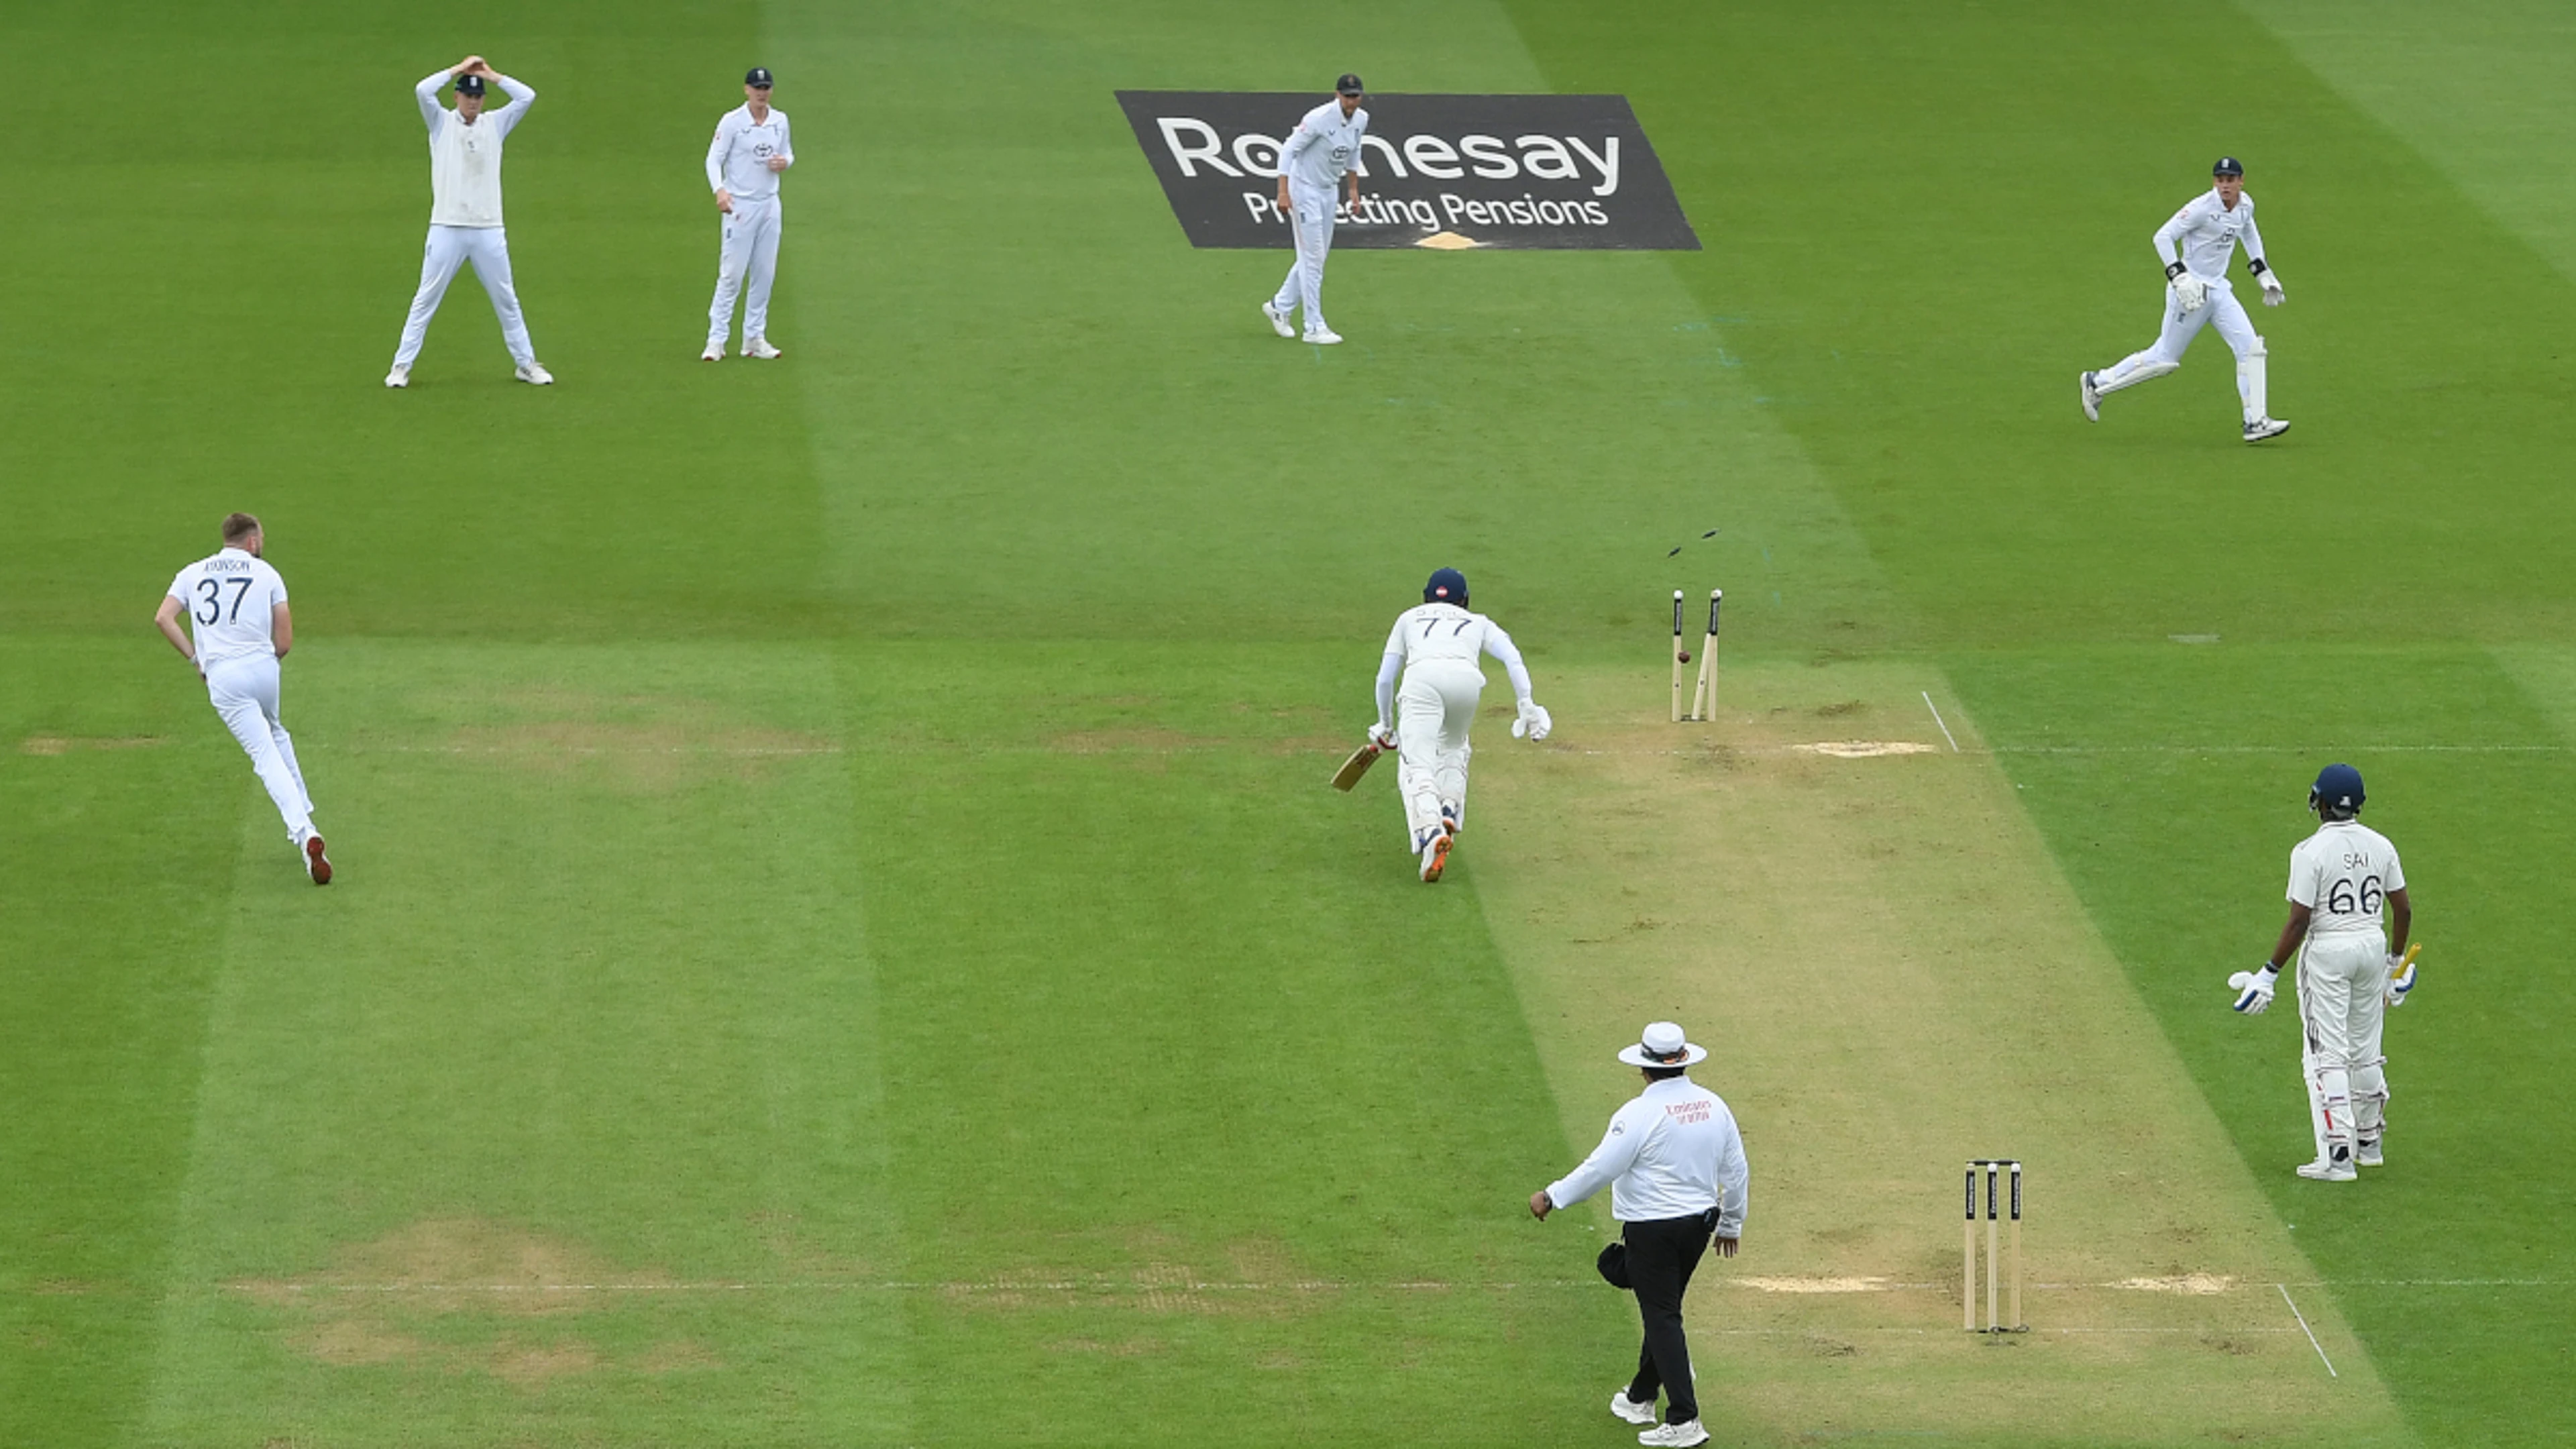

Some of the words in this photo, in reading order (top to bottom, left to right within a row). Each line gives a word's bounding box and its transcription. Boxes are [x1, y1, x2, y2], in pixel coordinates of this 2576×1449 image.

[1243, 193, 1441, 233] Precting
[1440, 193, 1609, 225] Pensions
[197, 577, 254, 625] 37
[1416, 617, 1472, 639] 77
[2344, 853, 2368, 870] SAI
[2328, 875, 2381, 914] 66
